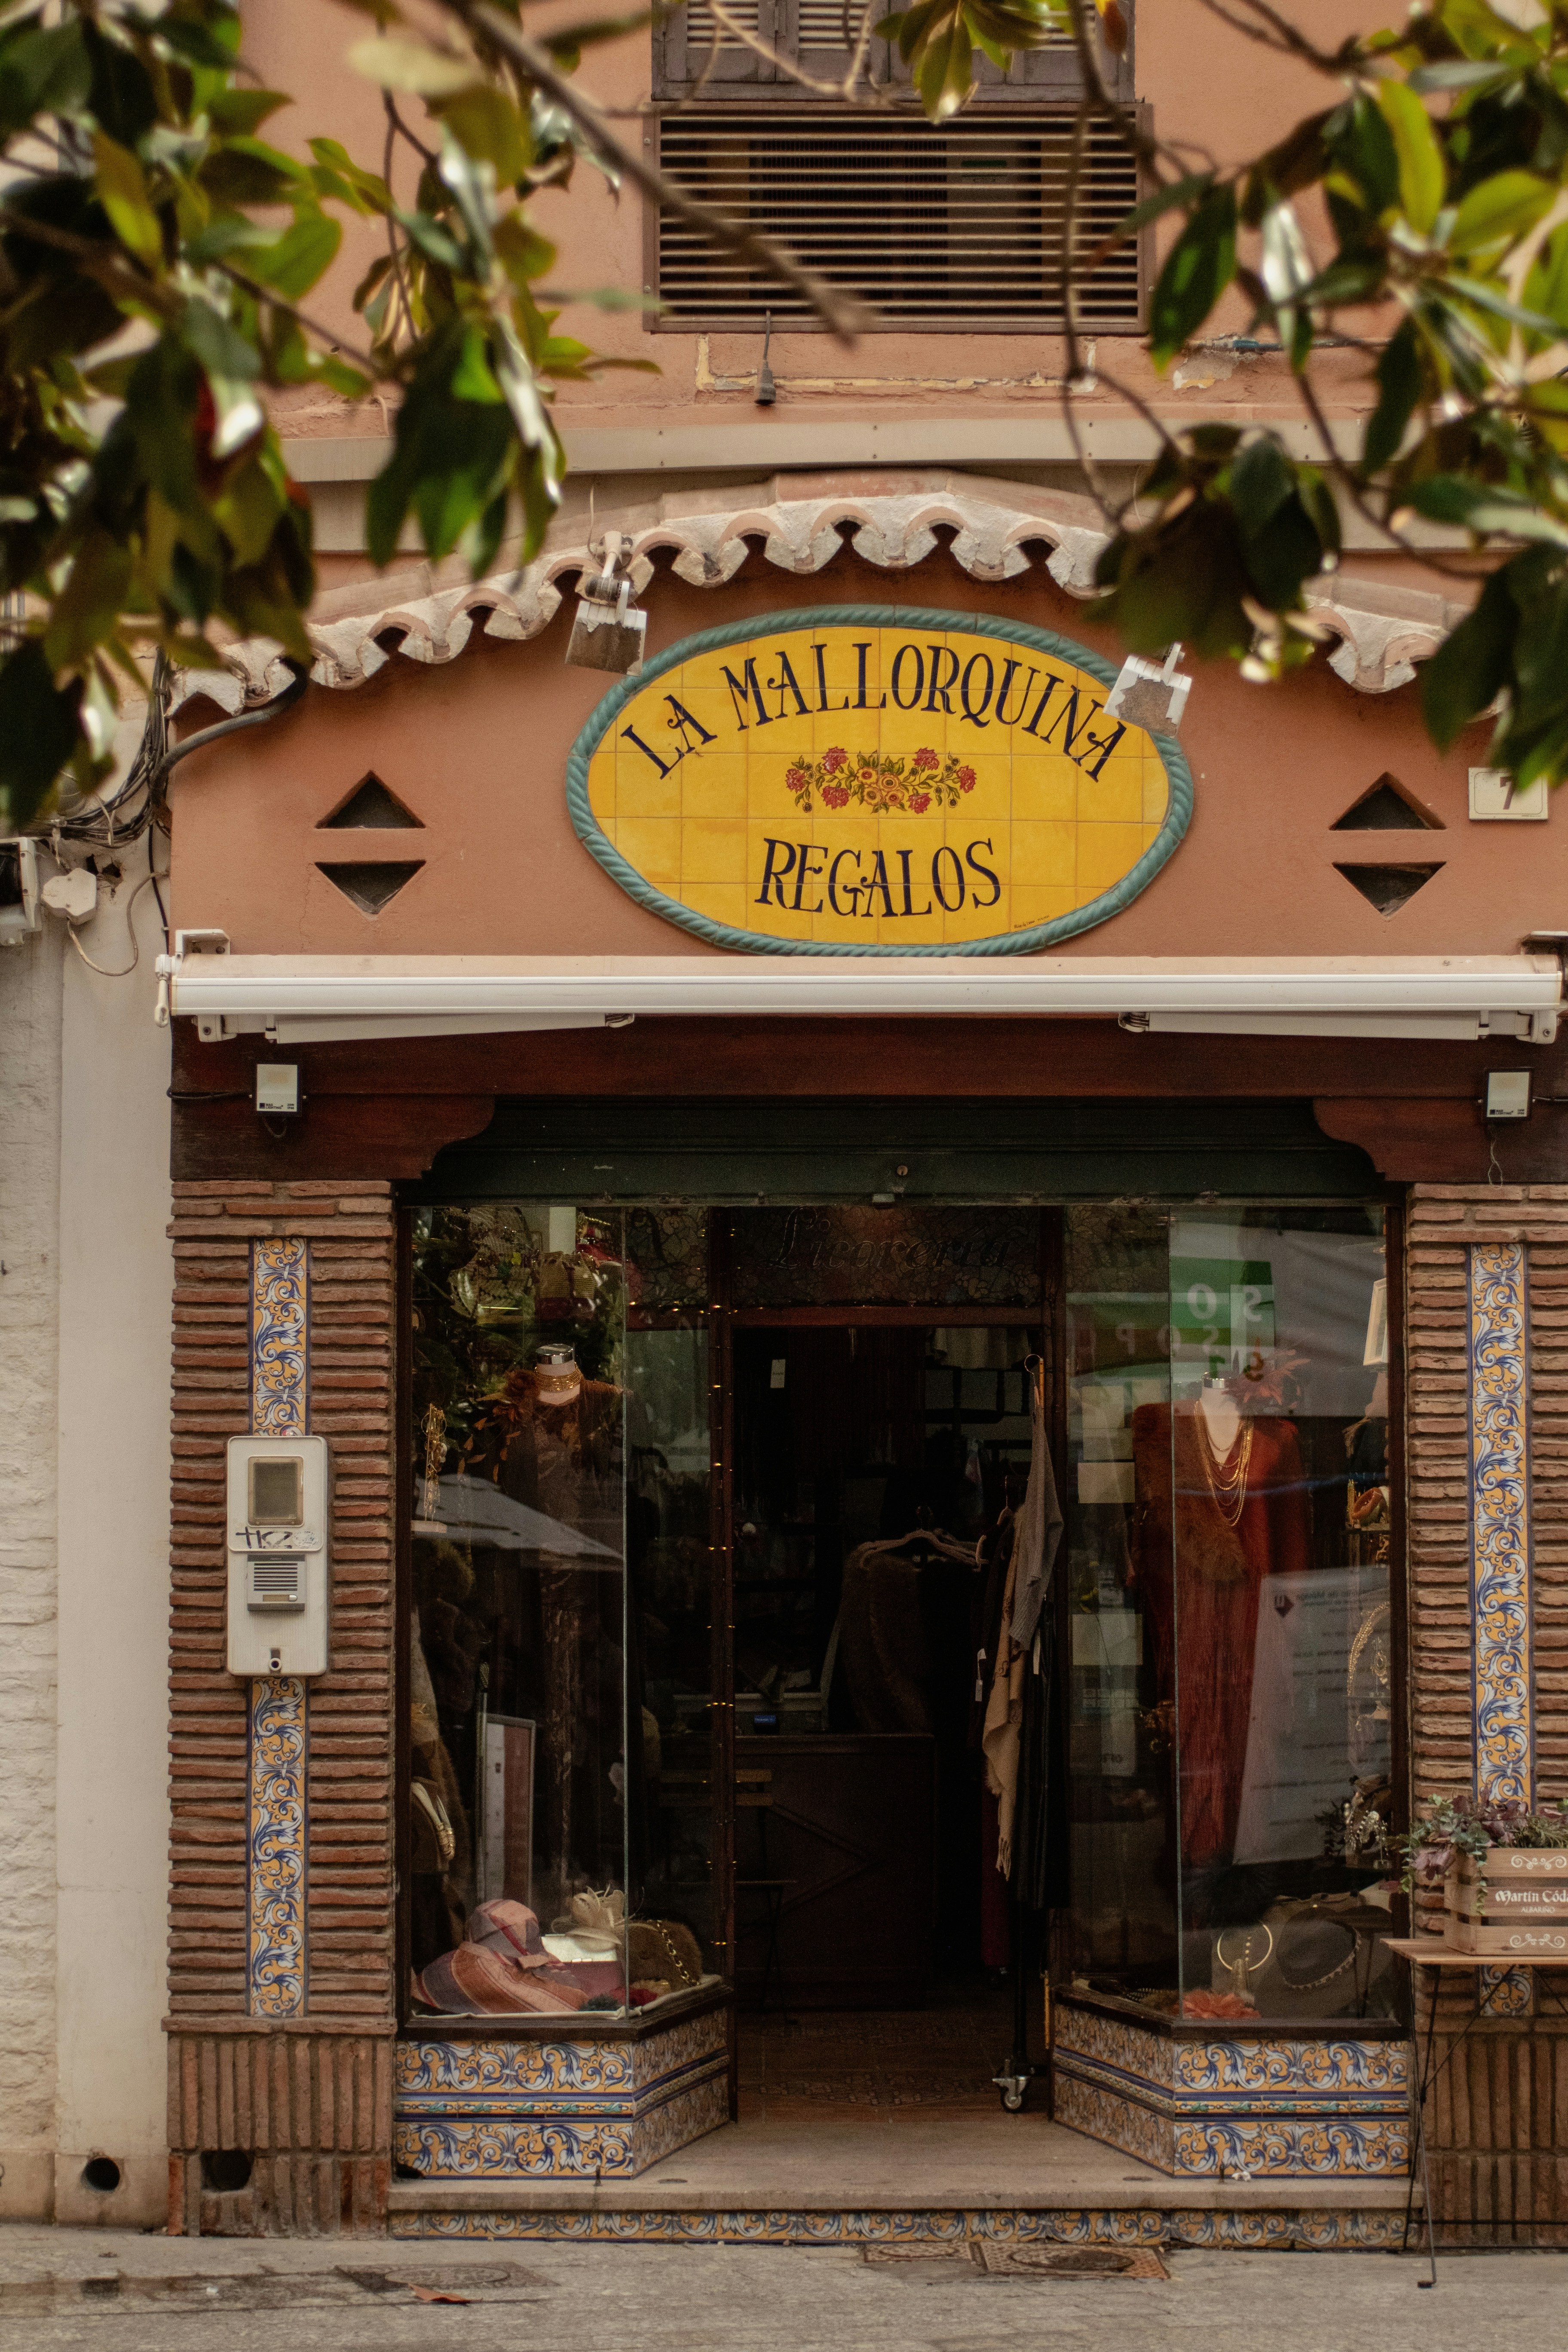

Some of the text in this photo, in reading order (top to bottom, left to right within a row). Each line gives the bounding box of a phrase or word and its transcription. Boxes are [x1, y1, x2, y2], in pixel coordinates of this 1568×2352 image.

[620, 643, 1127, 783] LA MALLORQUINA
[754, 838, 1001, 918] REGALOS
